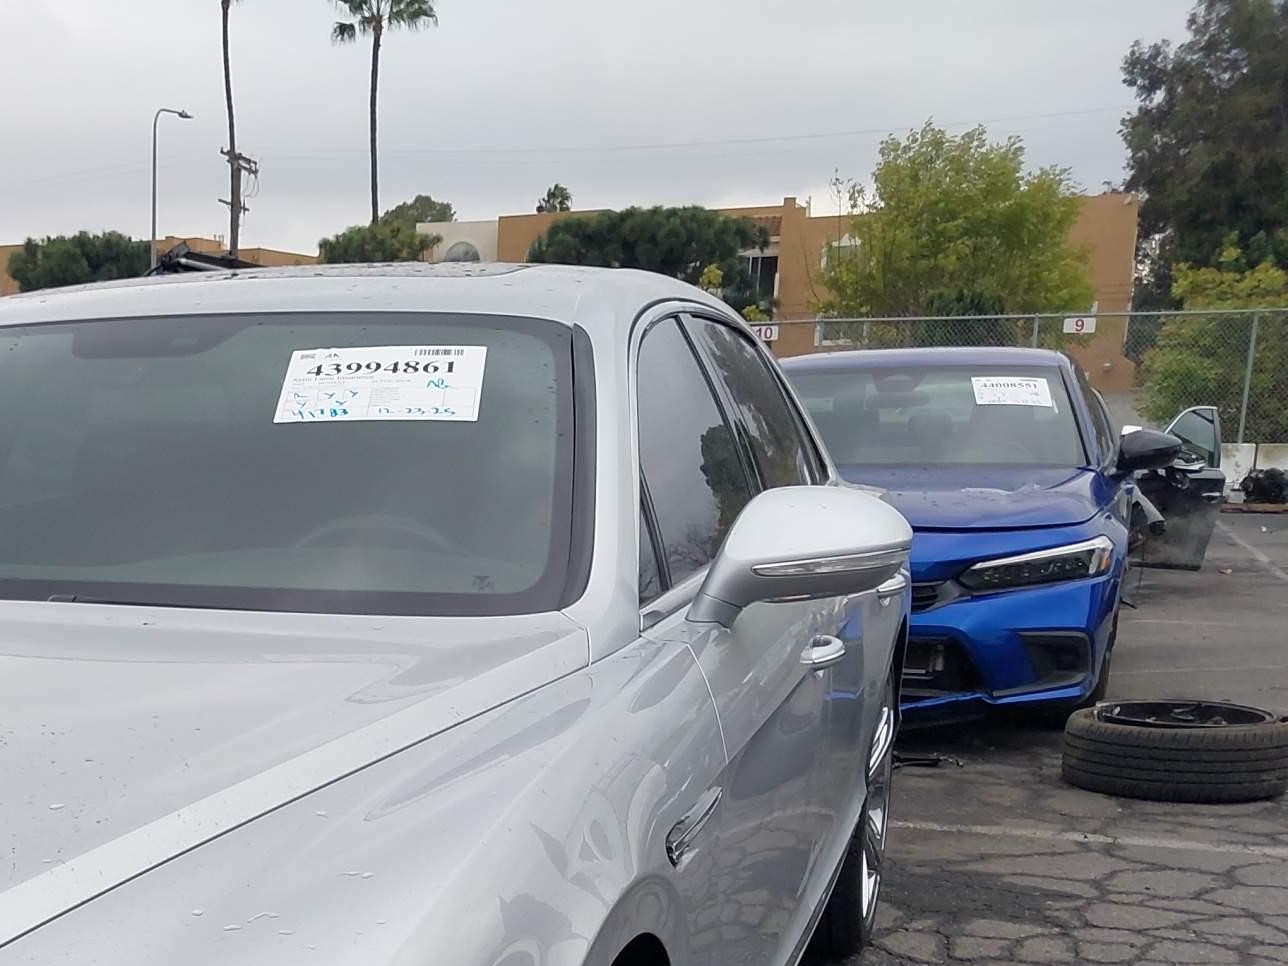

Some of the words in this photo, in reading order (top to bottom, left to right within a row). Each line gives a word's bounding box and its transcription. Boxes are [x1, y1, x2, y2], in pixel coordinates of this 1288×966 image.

[1075, 318, 1084, 332] 9
[756, 327, 773, 339] 10
[306, 361, 455, 377] 43994861
